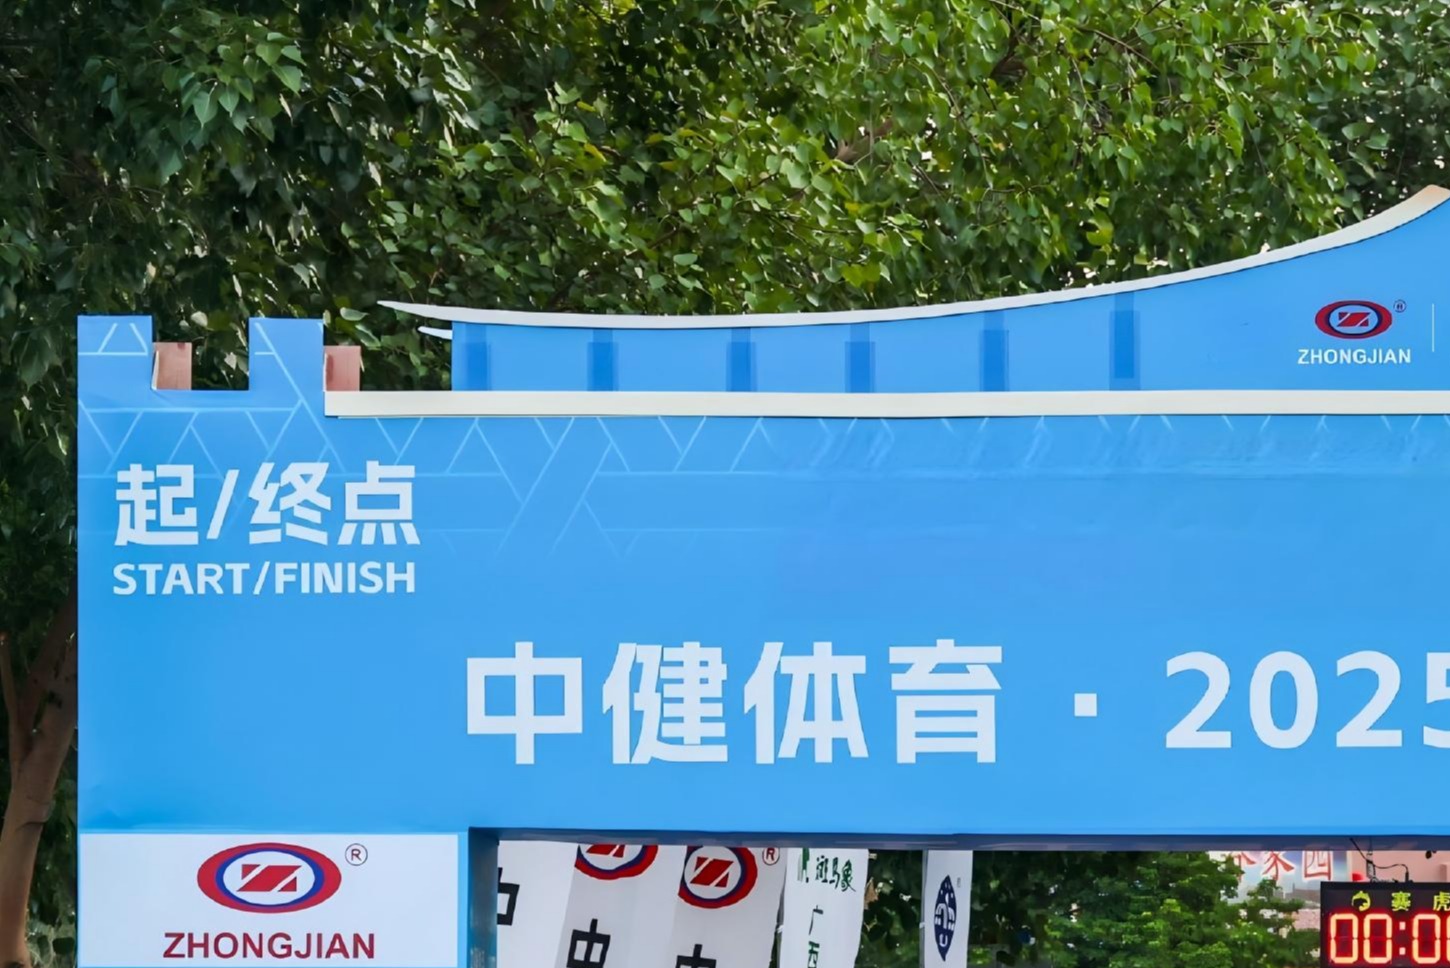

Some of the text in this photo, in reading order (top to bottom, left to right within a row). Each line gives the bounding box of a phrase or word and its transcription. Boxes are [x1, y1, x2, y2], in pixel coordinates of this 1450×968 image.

[1297, 348, 1411, 364] ZHONGJIAN
[114, 460, 421, 546] 起/终点
[112, 561, 415, 595] START/FINISH
[465, 638, 1003, 765] 中健体育
[162, 932, 375, 959] ZHONGJIAN
